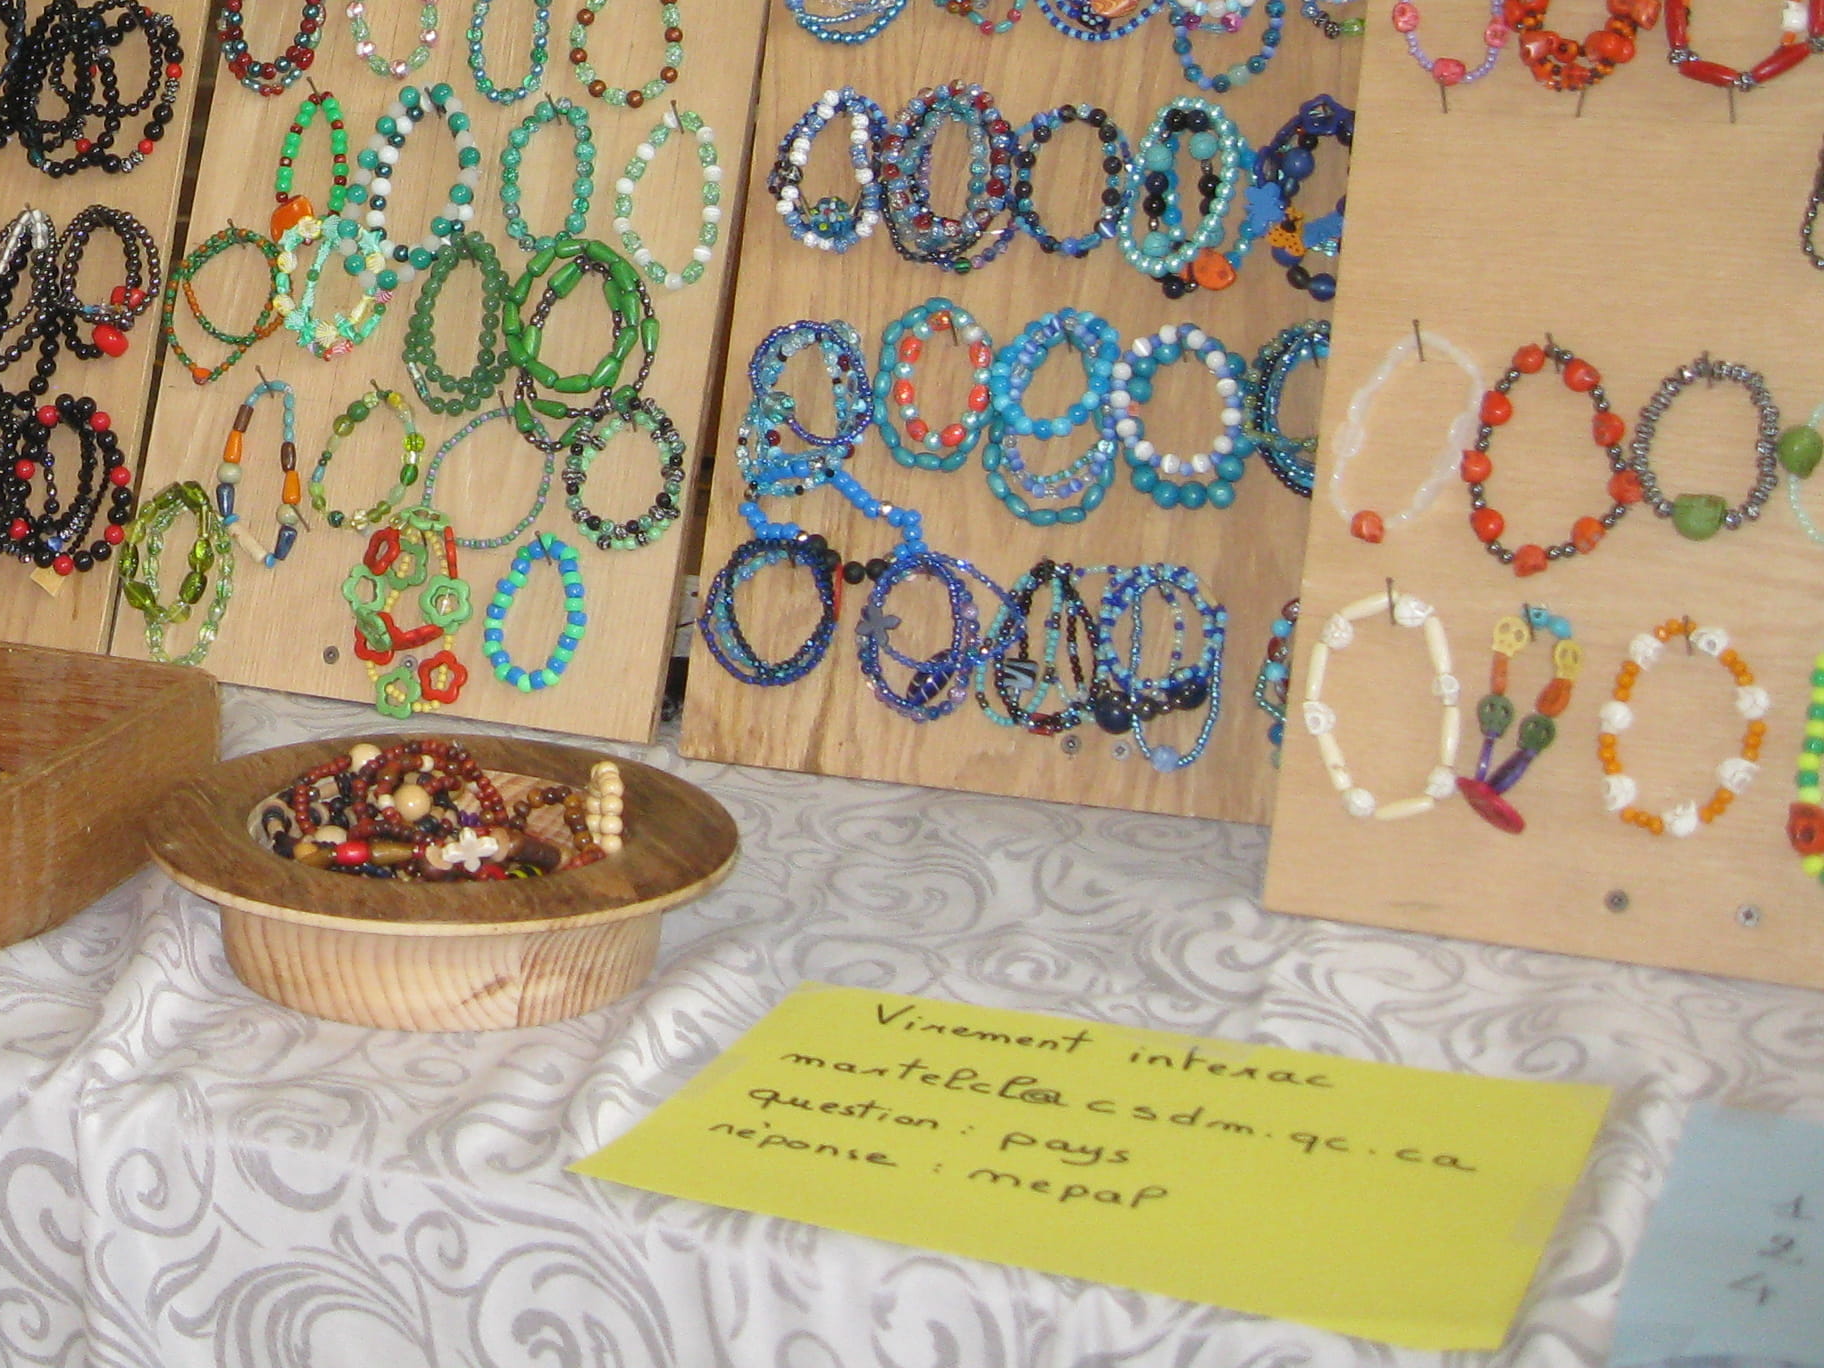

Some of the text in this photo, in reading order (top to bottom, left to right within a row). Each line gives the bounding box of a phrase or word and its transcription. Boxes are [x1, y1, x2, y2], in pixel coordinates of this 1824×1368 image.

[876, 1002, 1335, 1090] Virement interac
[747, 1087, 940, 1130] question
[998, 1130, 1131, 1167] pays
